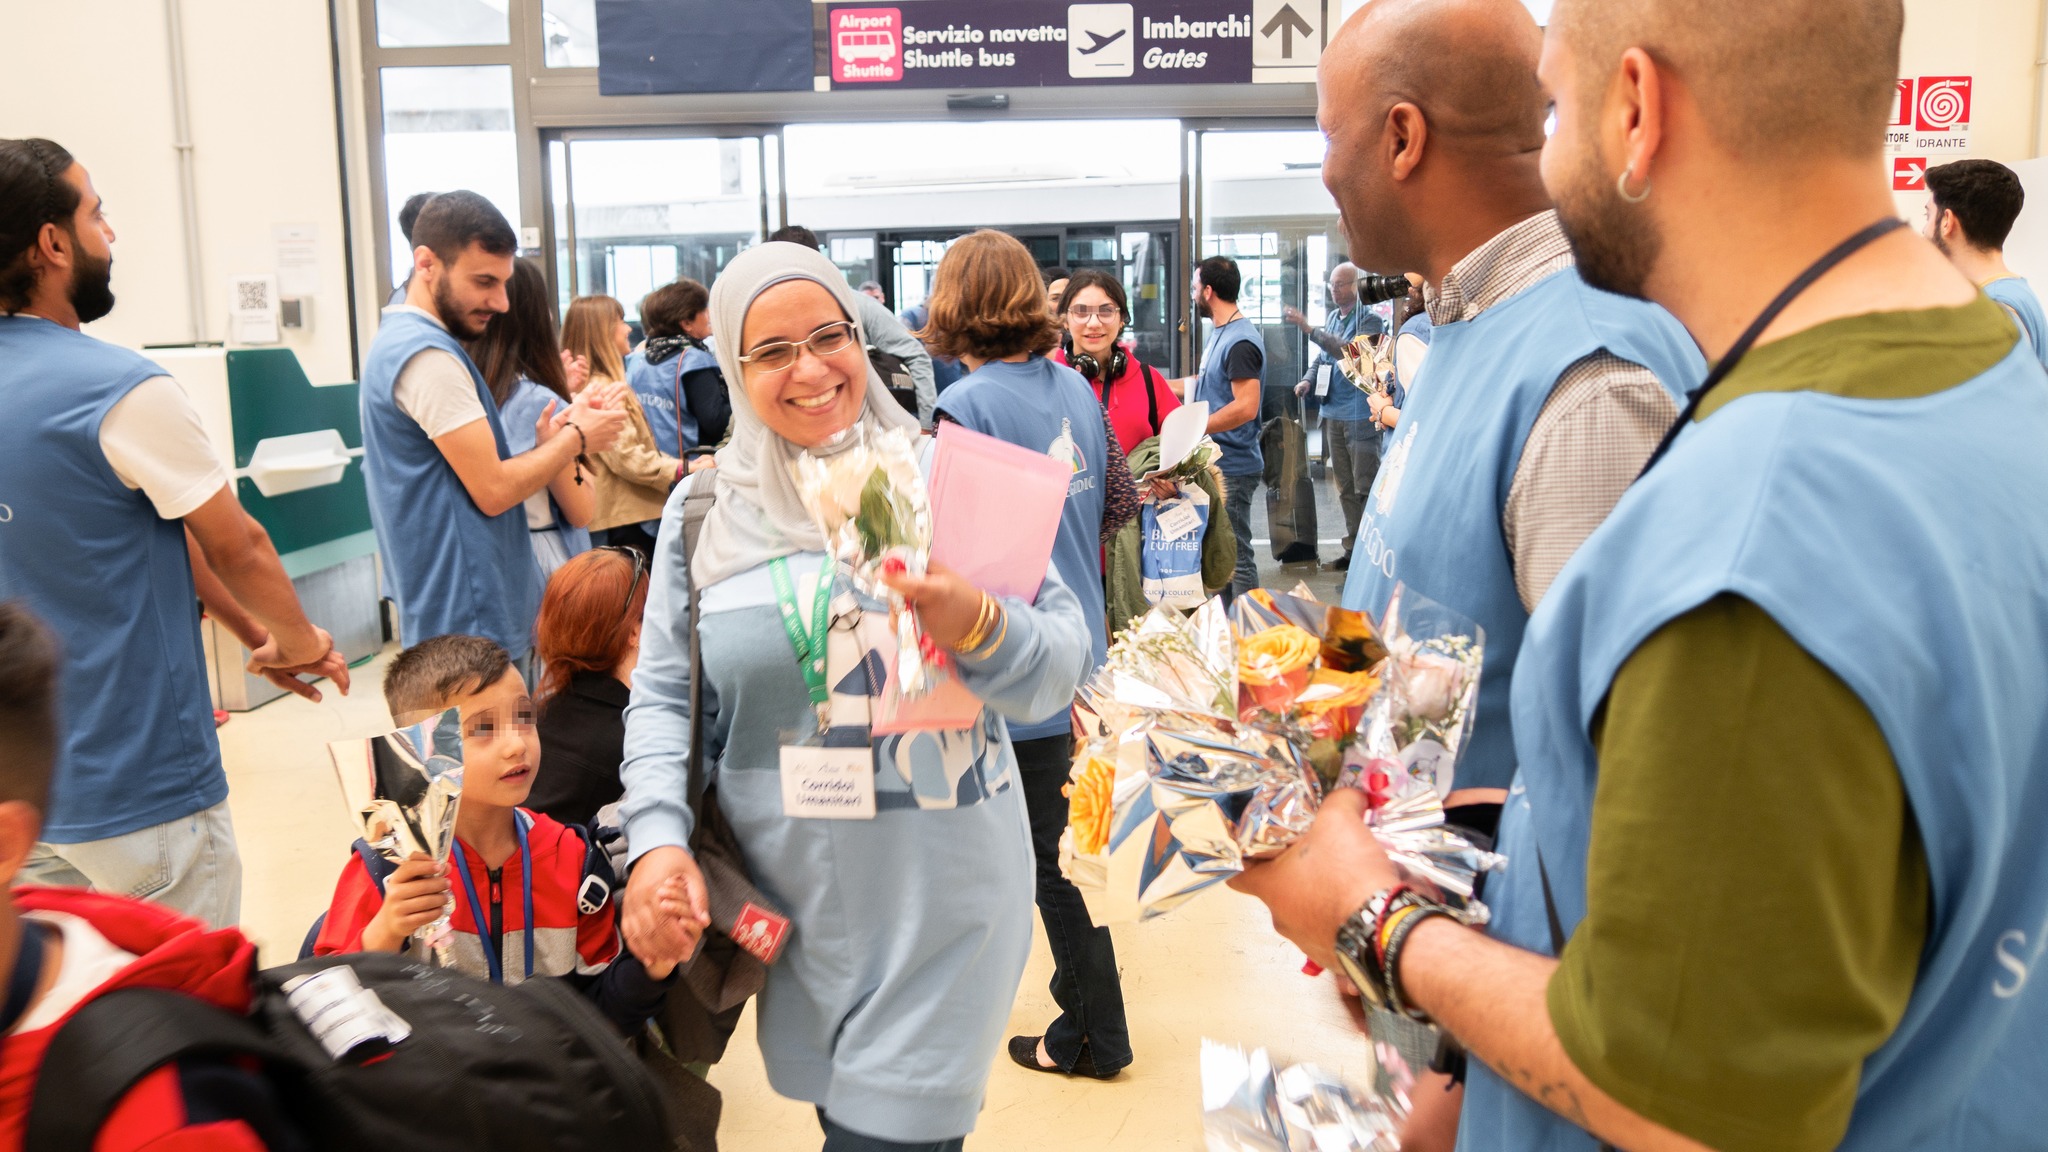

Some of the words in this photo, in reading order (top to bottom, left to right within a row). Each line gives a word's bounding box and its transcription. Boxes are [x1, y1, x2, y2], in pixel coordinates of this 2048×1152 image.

[839, 14, 892, 30] Airport
[1142, 14, 1250, 39] Imbarchi
[903, 24, 984, 44] Servizio
[990, 25, 1067, 42] navetta
[904, 48, 973, 68] Shuttle
[979, 47, 1016, 67] bus
[1142, 46, 1208, 69] Gates
[843, 64, 894, 78] Shuttle
[1916, 138, 1966, 148] IDRANTE
[1176, 541, 1199, 551] FREE
[1992, 929, 2028, 998] S
